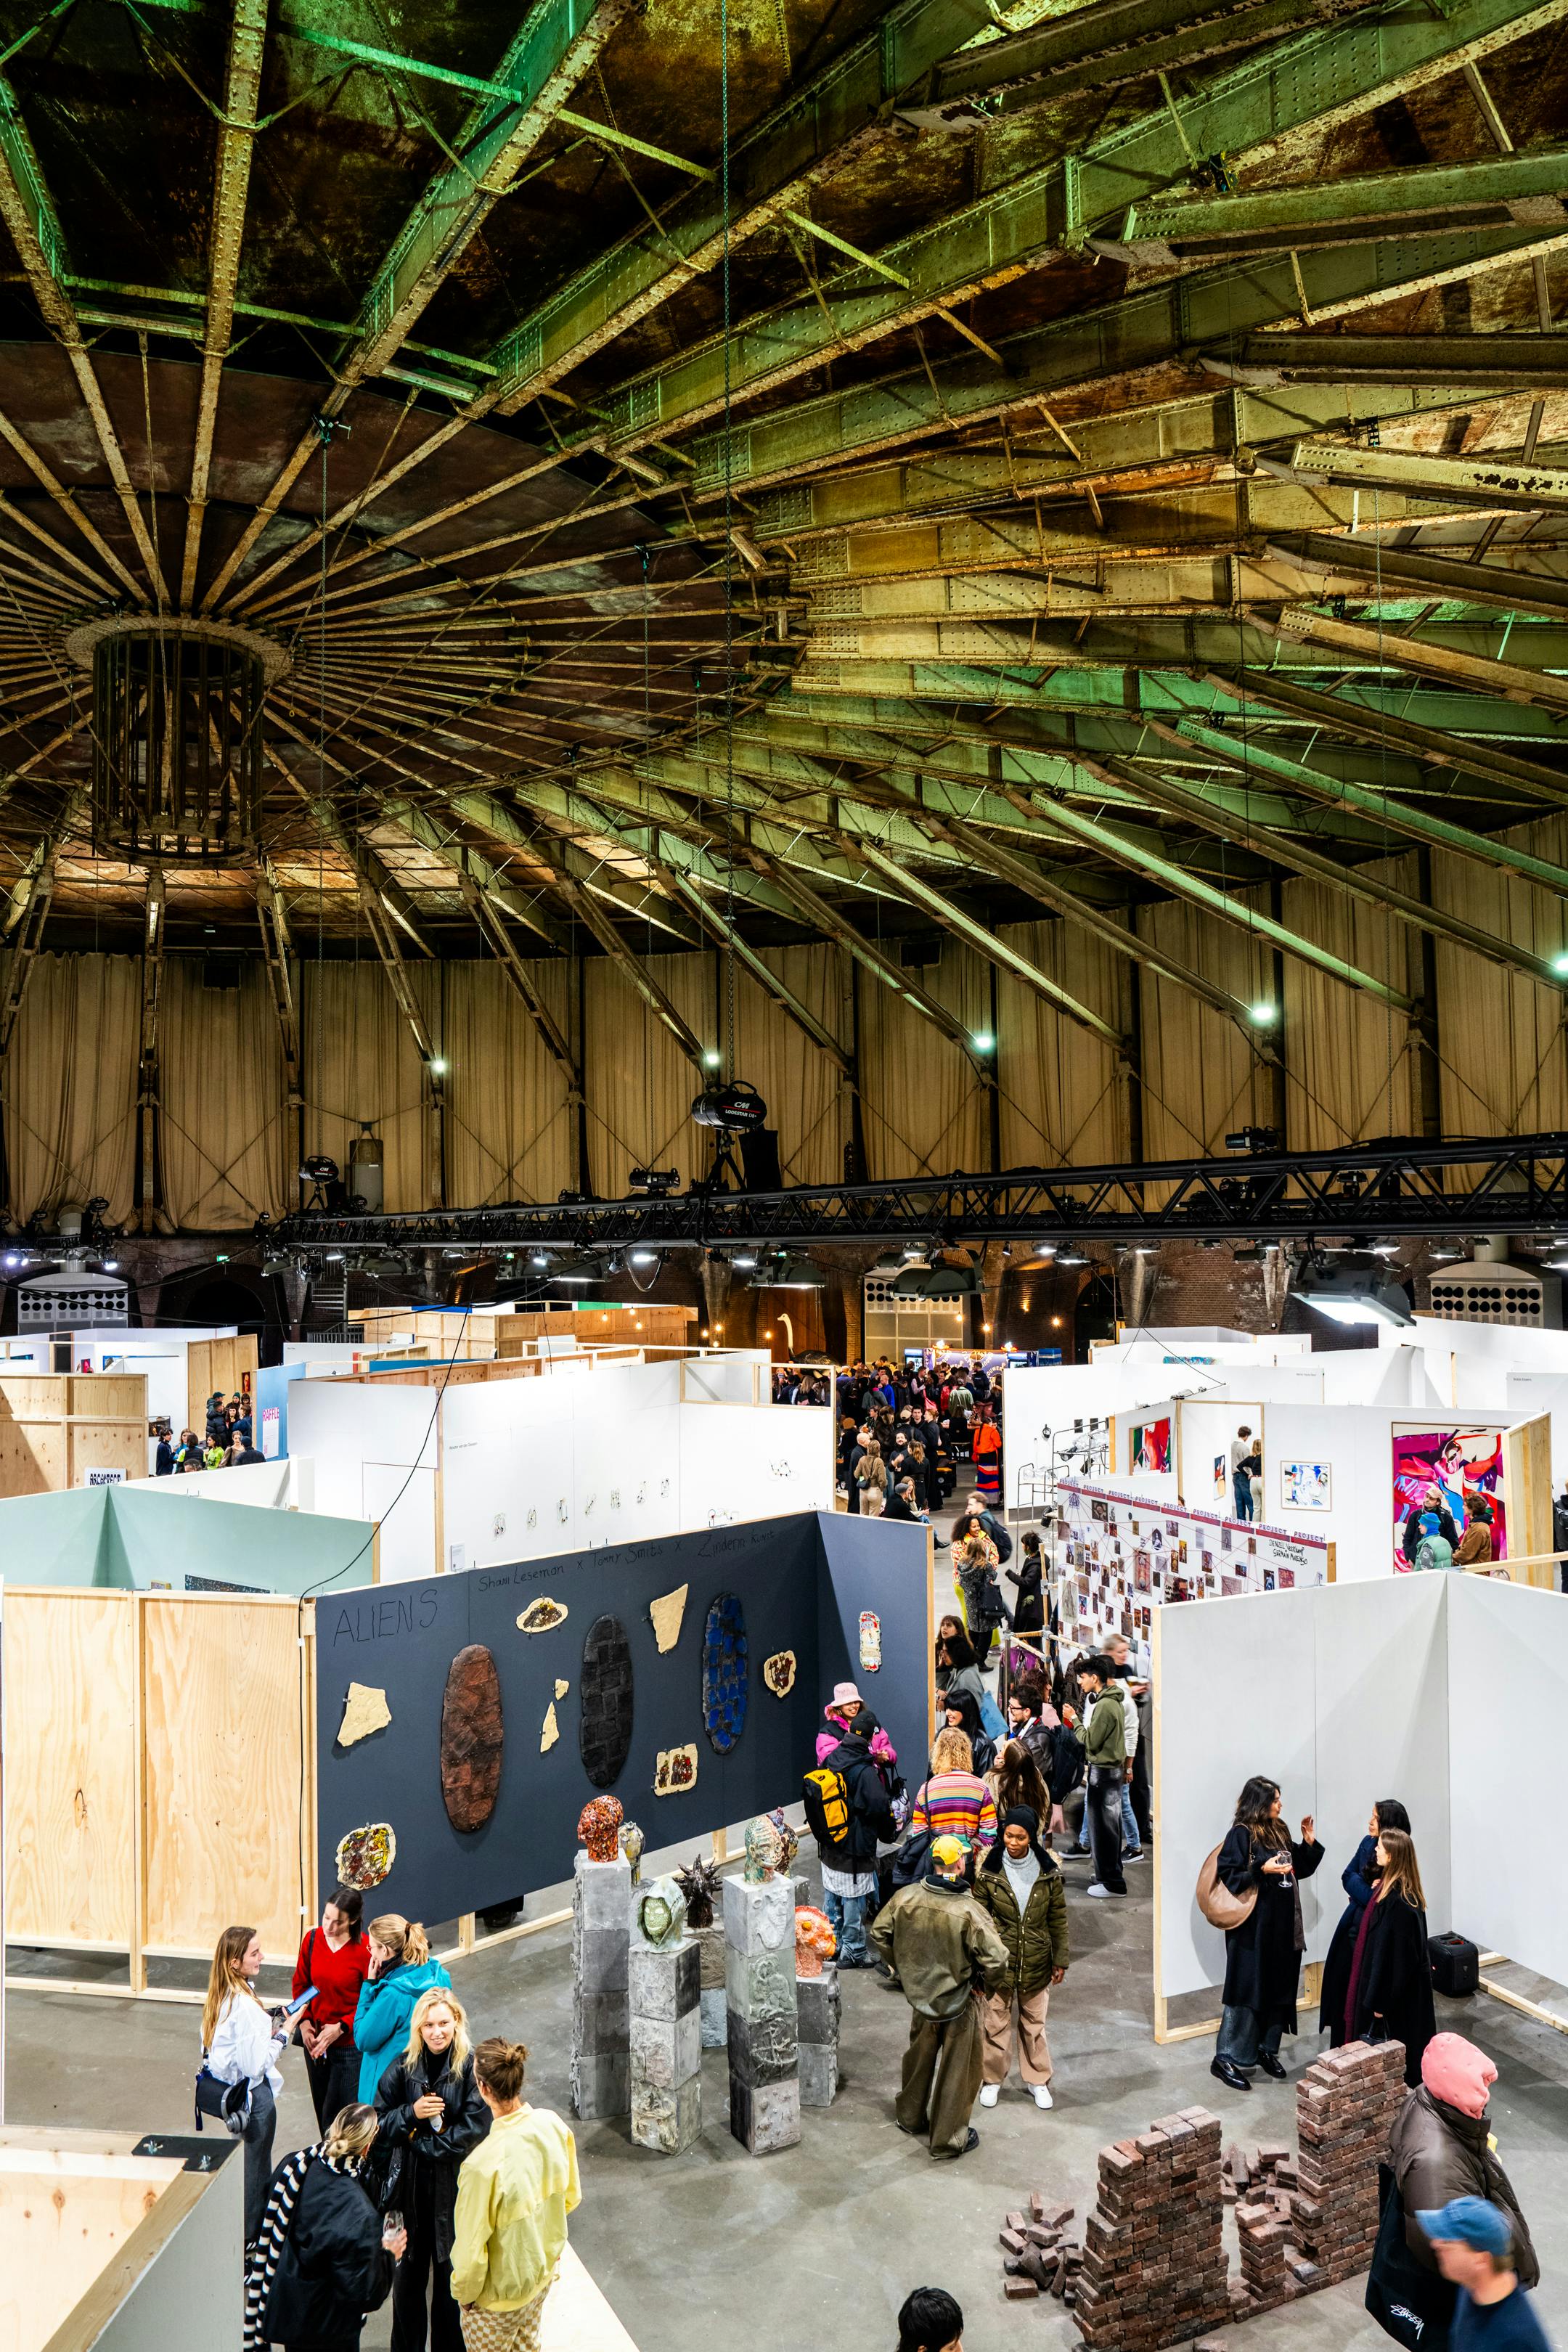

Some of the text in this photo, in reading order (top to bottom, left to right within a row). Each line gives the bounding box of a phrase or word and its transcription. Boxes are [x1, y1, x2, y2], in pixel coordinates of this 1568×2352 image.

[262, 1407, 279, 1421] RAFFLE
[1059, 1478, 1324, 1543] PROJECT PROJECT PROJECT PROJECT PROJECT PROJECT PROJECT PROJECT PROJECT
[624, 1542, 663, 1564] Smits
[333, 1588, 438, 1648] ALIENS
